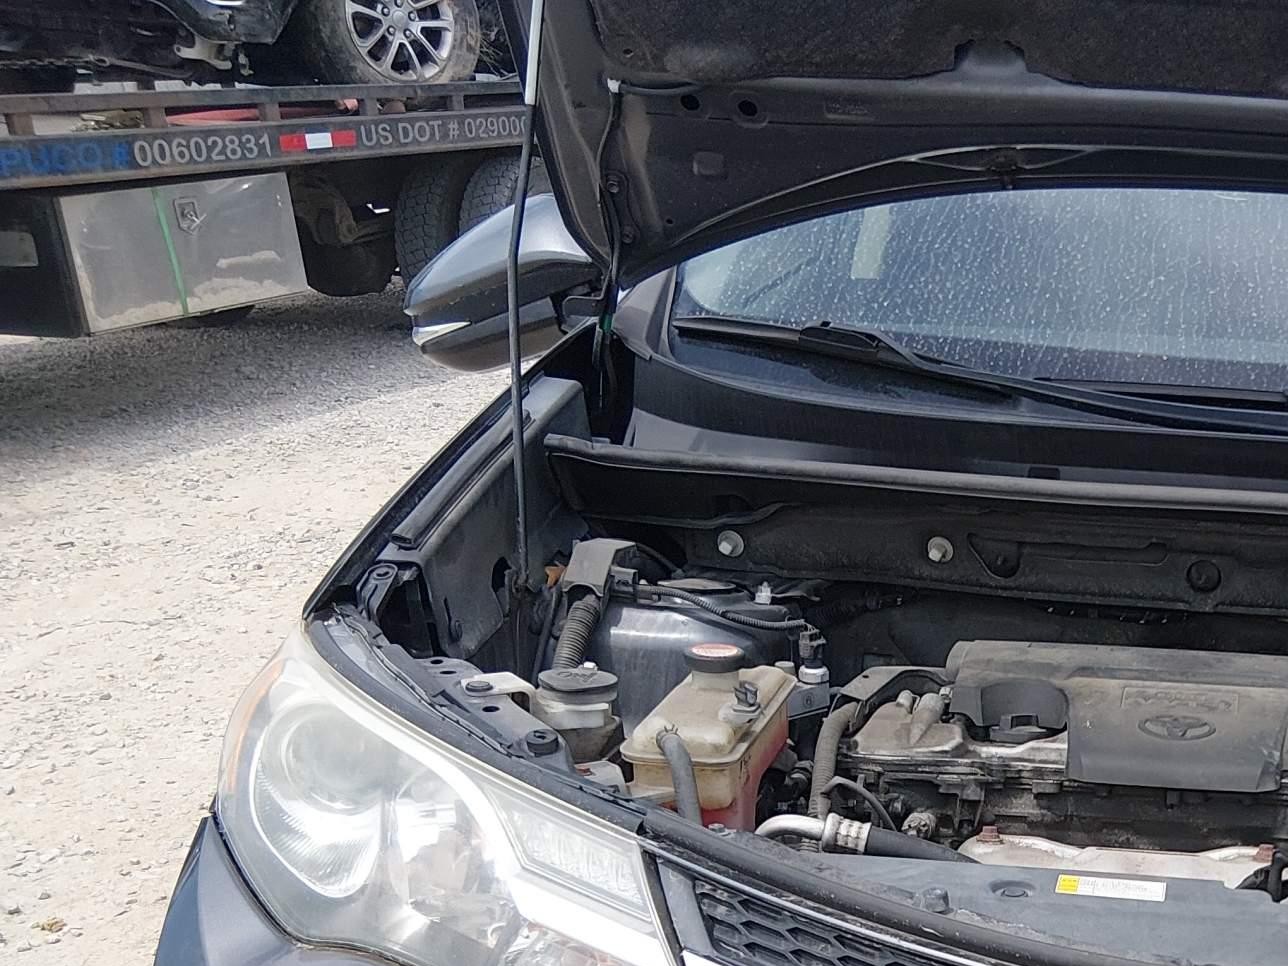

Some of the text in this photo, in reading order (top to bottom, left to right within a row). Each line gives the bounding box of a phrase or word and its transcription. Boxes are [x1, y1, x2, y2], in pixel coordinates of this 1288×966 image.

[360, 123, 393, 147] US
[398, 120, 442, 144] DOT
[448, 123, 460, 140] #
[133, 132, 272, 168] 00602831
